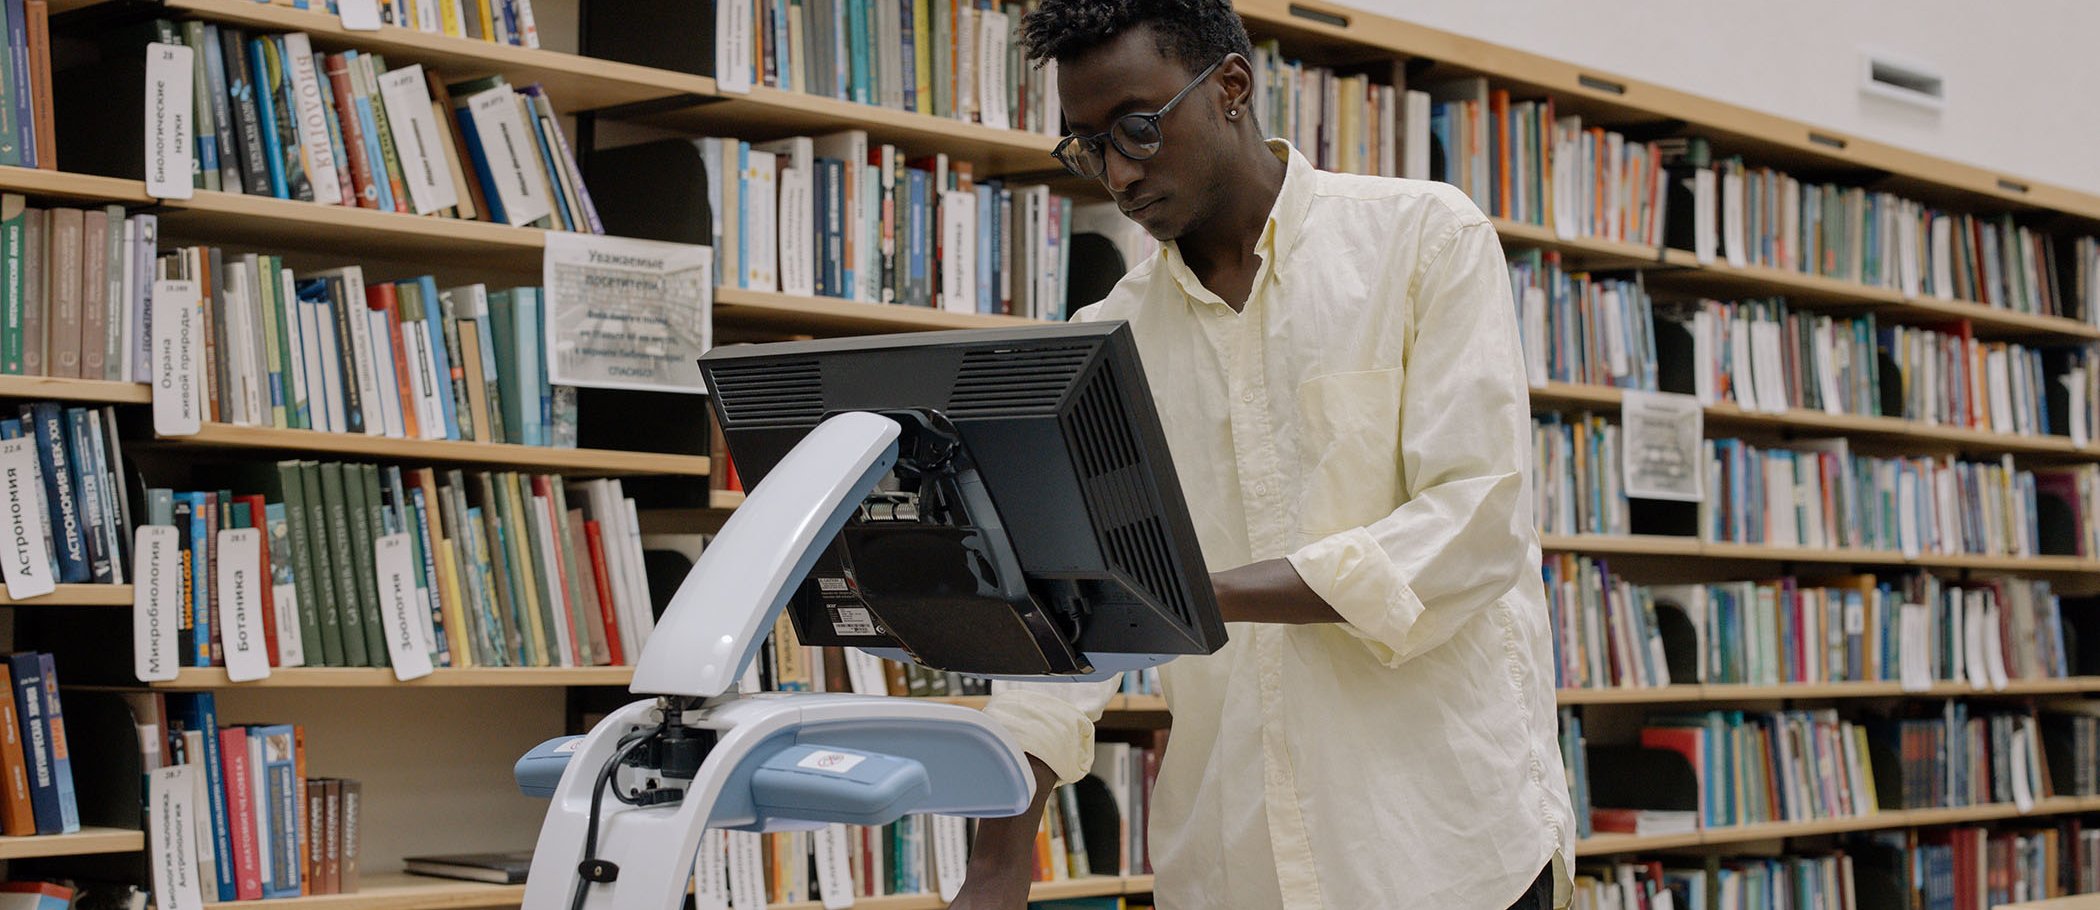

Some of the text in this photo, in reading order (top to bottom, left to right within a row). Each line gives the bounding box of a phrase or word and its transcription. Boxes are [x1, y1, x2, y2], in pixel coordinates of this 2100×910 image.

[154, 79, 166, 184] Биологические
[174, 113, 183, 154] науки
[297, 54, 333, 171] БИОЛОГИЯ
[9, 225, 19, 327] МАТЕМАТИЧЕСКИЙ АНАЛИЗ
[589, 249, 665, 270] Уважаемые
[143, 297, 152, 352] ГЕОМЕТРИЯ
[161, 337, 173, 390] Охрана
[181, 307, 192, 421] живой природы
[6, 466, 33, 577] Астрономия
[46, 418, 83, 563] АСТРОНОМИЯ: ВЕК XXI
[149, 540, 161, 674] Микробиология
[233, 568, 249, 653] Ботаника
[327, 608, 337, 626] 2
[391, 573, 413, 652] Зоология
[163, 788, 178, 910] Биология человека.
[174, 802, 188, 889] Антропология
[234, 755, 254, 871] АНАТОМИЯ ЧЕЛОВЕКА
